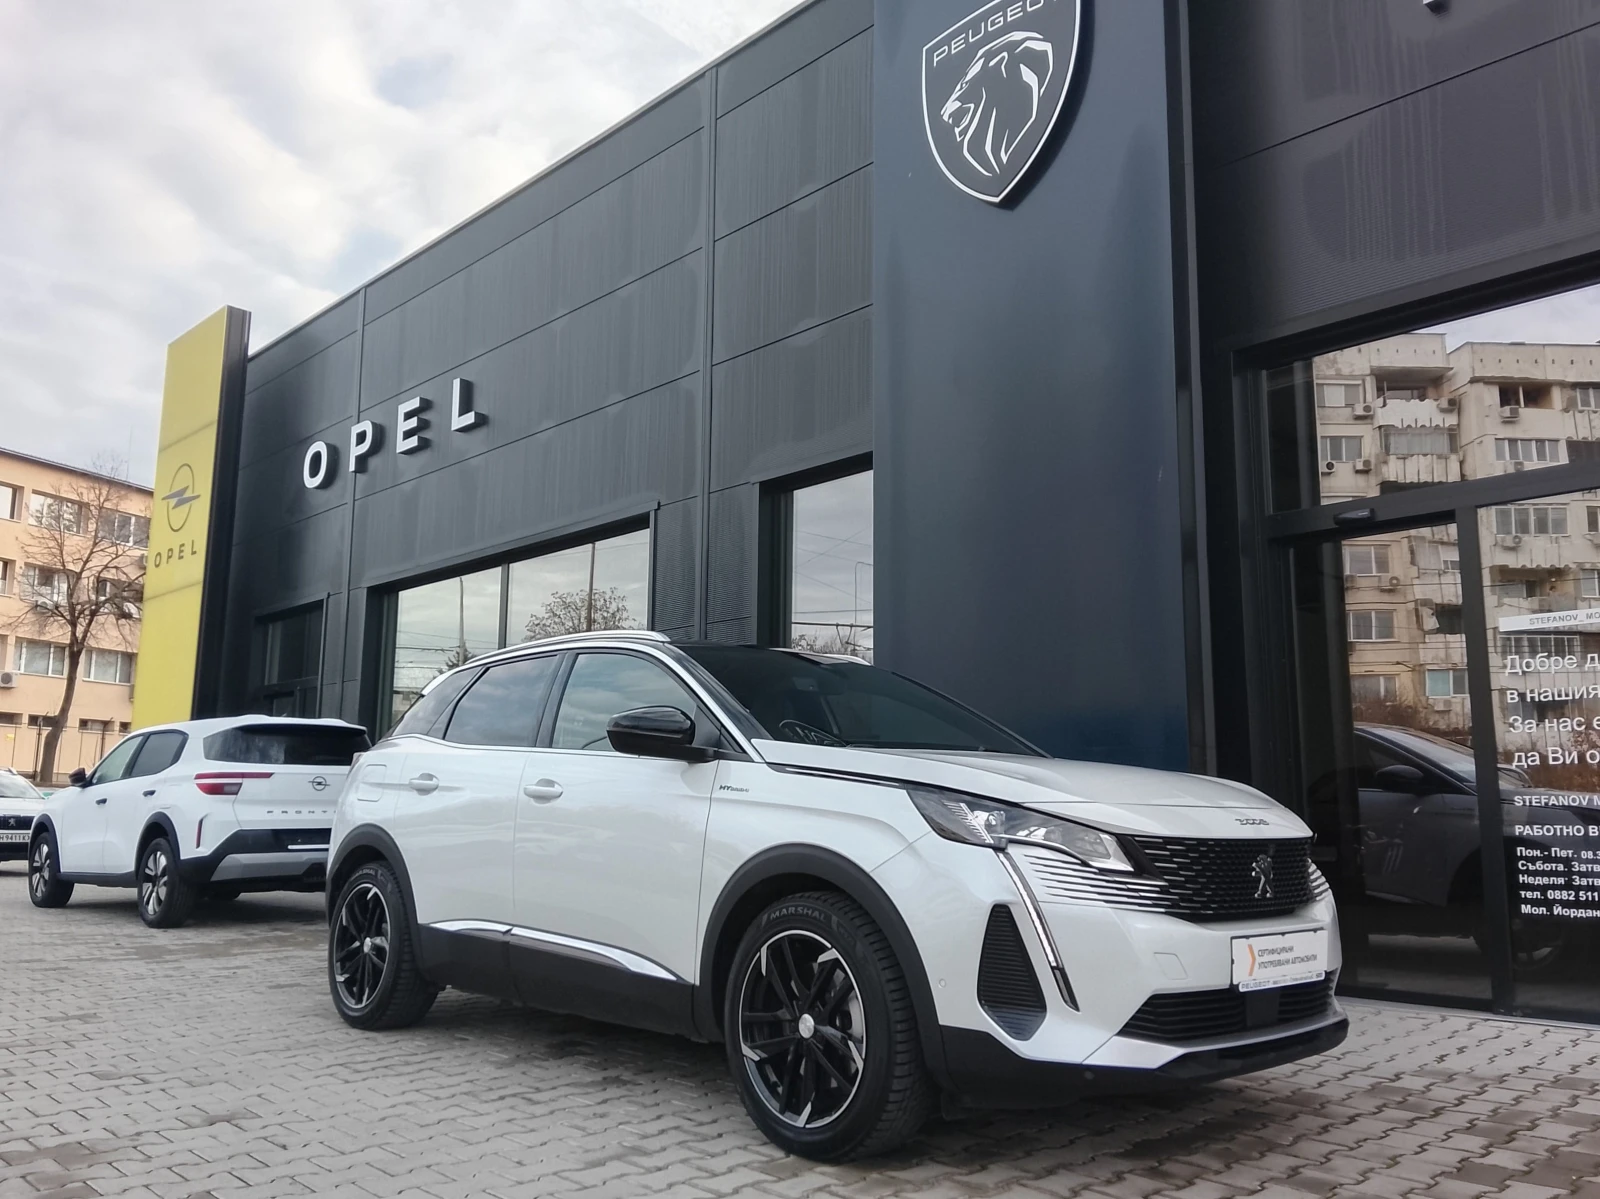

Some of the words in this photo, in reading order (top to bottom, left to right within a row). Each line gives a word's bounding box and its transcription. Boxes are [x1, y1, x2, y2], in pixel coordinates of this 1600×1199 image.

[933, 0, 1055, 67] PEUGEO
[303, 377, 475, 489] OPEL
[154, 539, 197, 568] OPEL
[1505, 652, 1578, 676] Добре
[1507, 690, 1519, 703] в
[1526, 685, 1600, 702] нашия
[1509, 715, 1537, 733] За
[1545, 716, 1587, 732] нас
[1512, 752, 1540, 768] да
[1548, 747, 1579, 765] Ви
[1514, 795, 1589, 806] STEFANOV
[1515, 825, 1585, 836] РАБОТНО
[1589, 825, 1600, 836] В
[1551, 848, 1577, 858] Пет.
[1518, 860, 1568, 871] Събота.
[1520, 890, 1544, 899] тел.
[1547, 890, 1576, 901] 0882
[1579, 891, 1599, 901] 511
[769, 906, 826, 921] MARSHAL
[1553, 904, 1600, 918] Йордан
